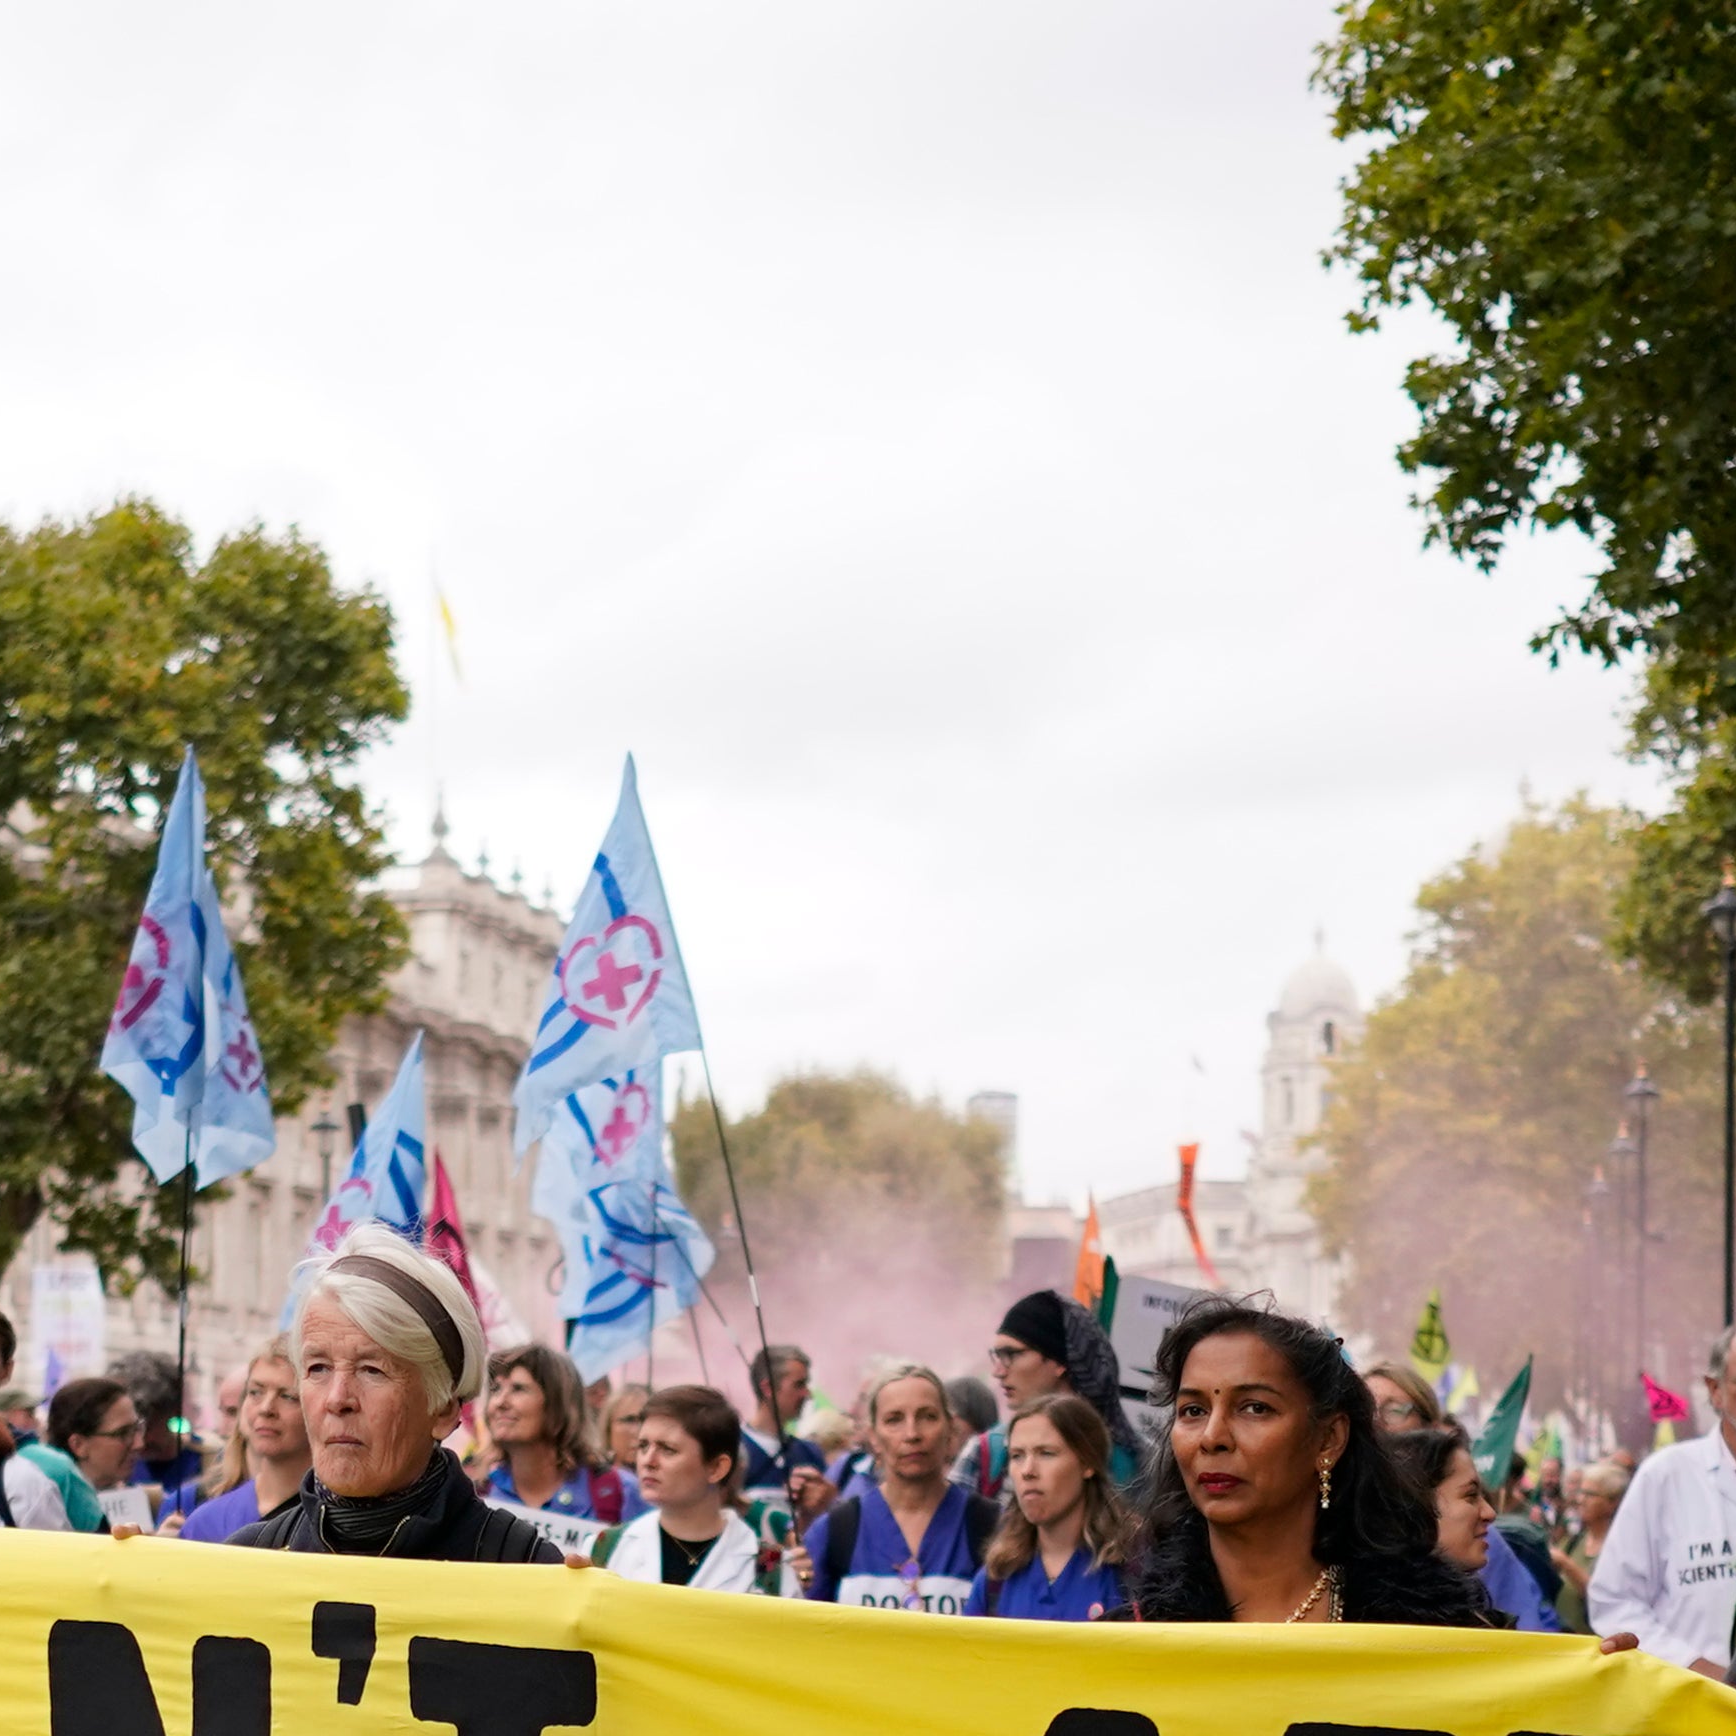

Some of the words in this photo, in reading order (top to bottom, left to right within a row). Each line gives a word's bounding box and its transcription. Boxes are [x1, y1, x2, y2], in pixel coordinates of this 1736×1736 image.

[1689, 1542, 1714, 1560] I'M
[1722, 1540, 1732, 1555] A
[862, 1594, 968, 1616] DOTO
